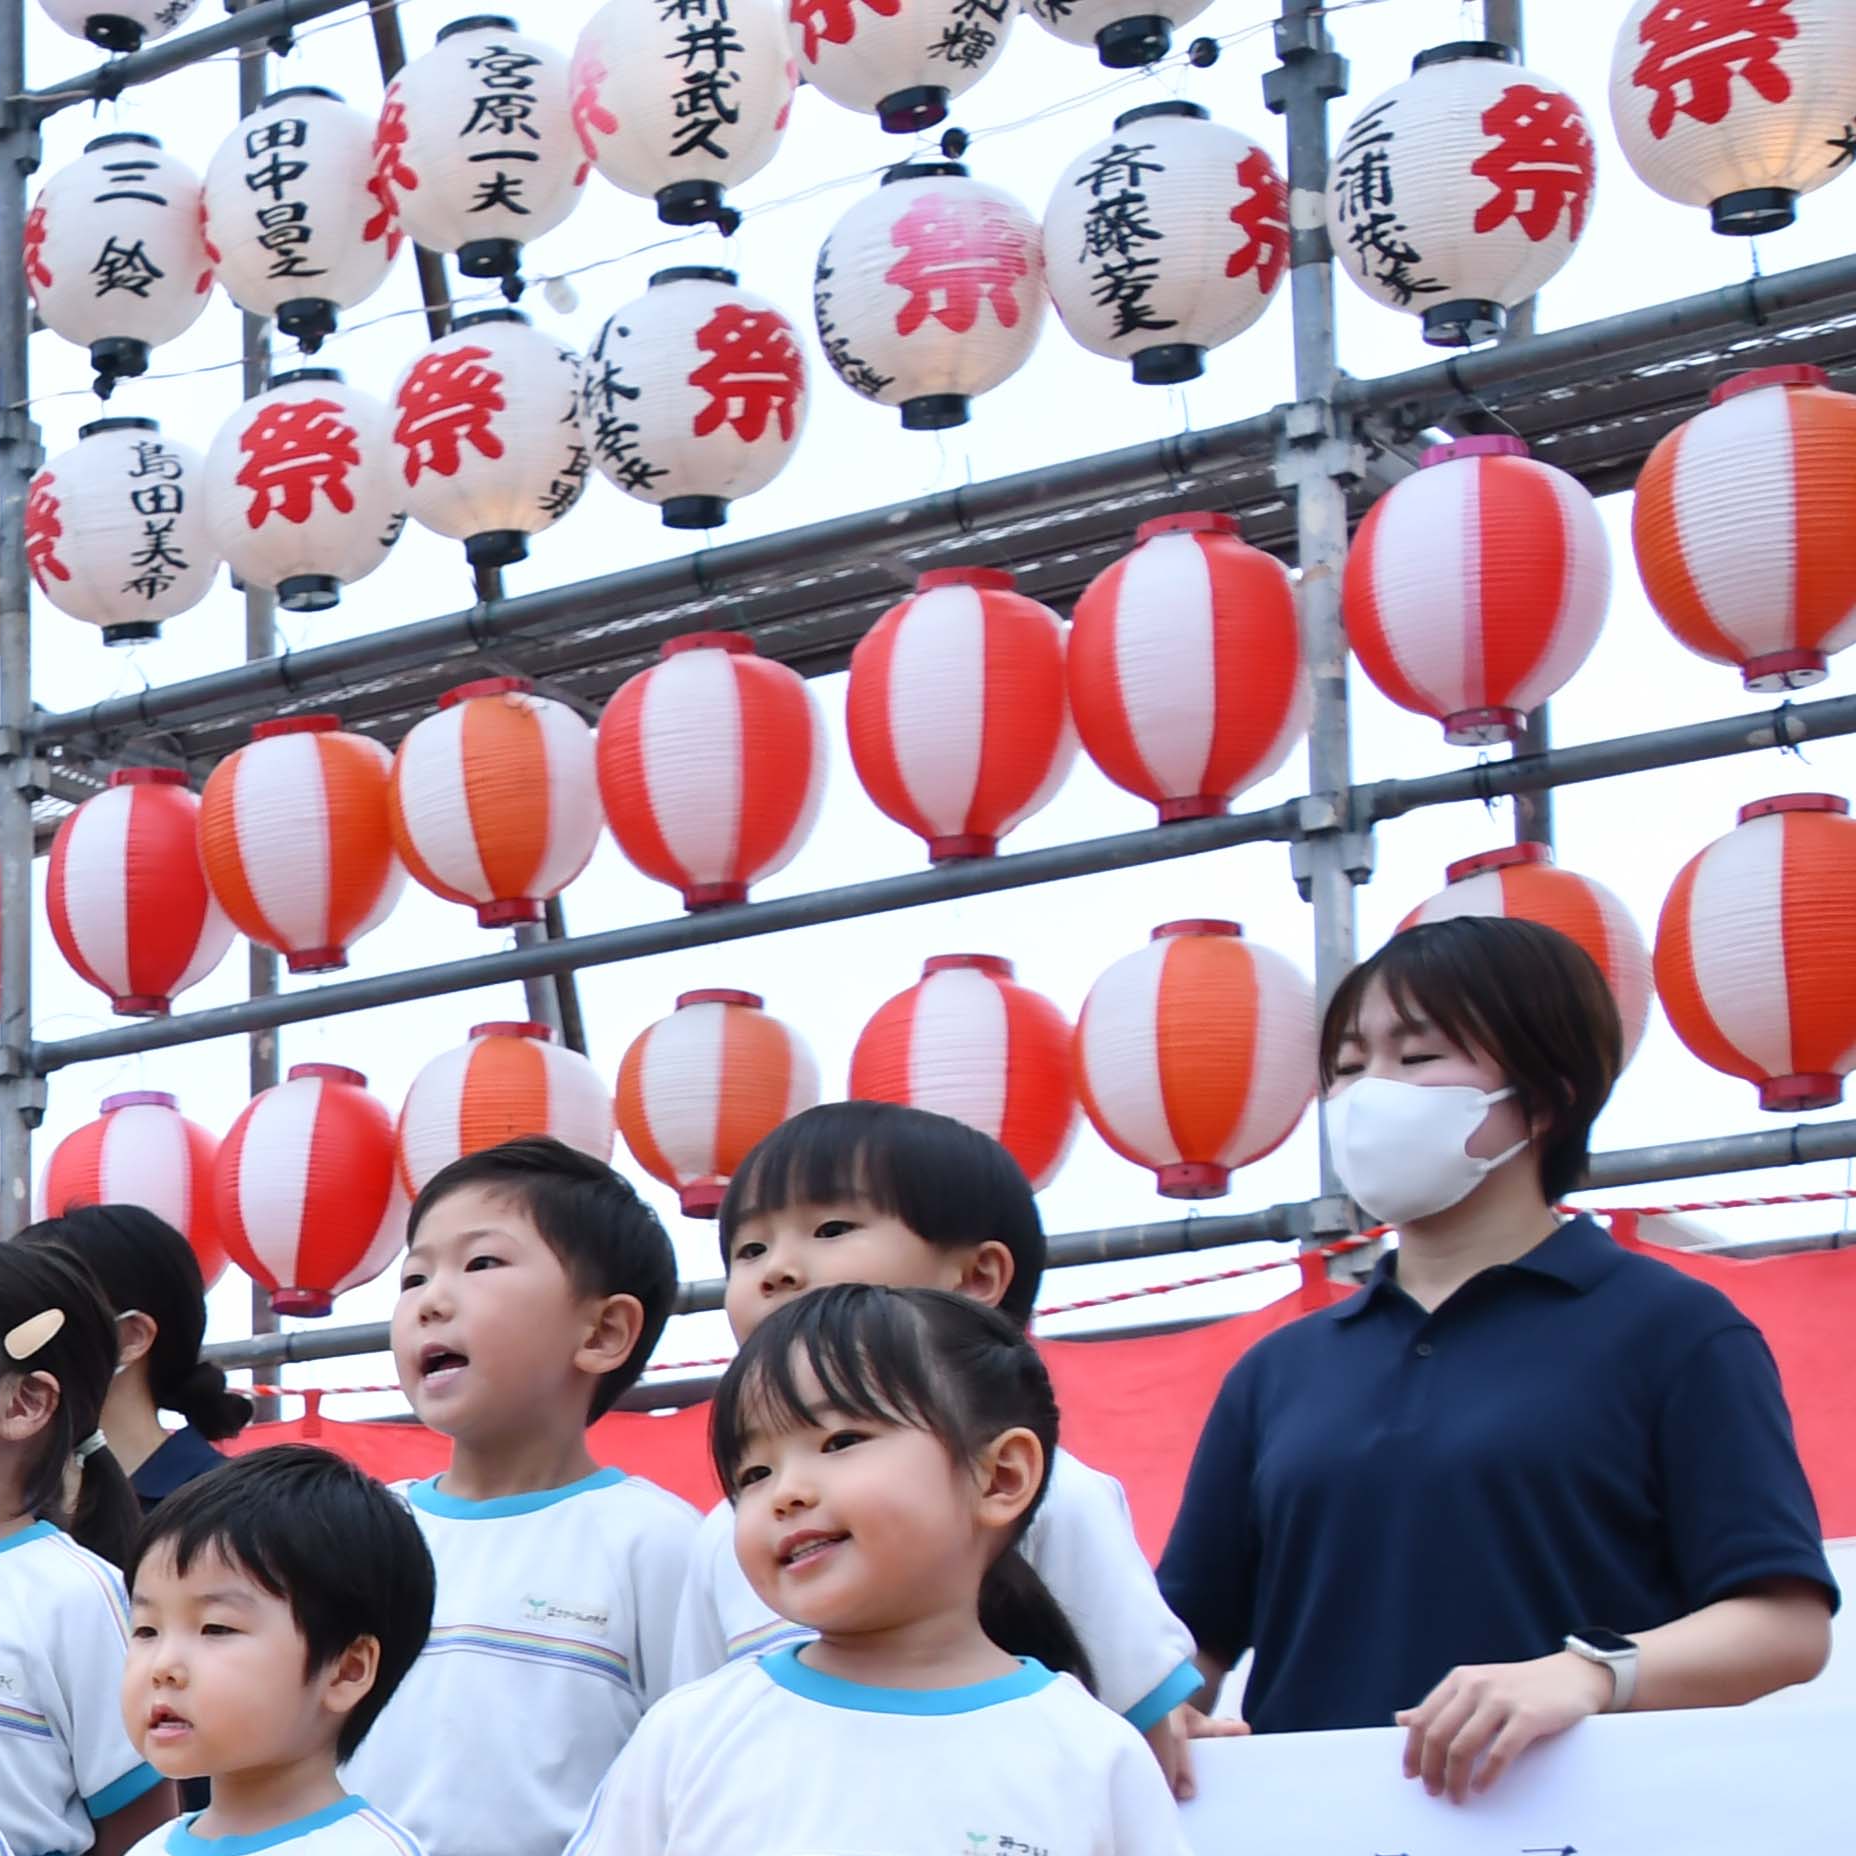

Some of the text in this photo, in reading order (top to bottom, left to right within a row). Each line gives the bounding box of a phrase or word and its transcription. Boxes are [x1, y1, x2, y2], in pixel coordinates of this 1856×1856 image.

[459, 45, 544, 216] 宮原一夫
[1633, 0, 1799, 140] 祭
[1471, 85, 1593, 242] 祭
[885, 194, 1028, 338] 祭
[393, 347, 506, 487] 祭
[688, 305, 803, 443] 祭
[236, 399, 361, 529] 祭
